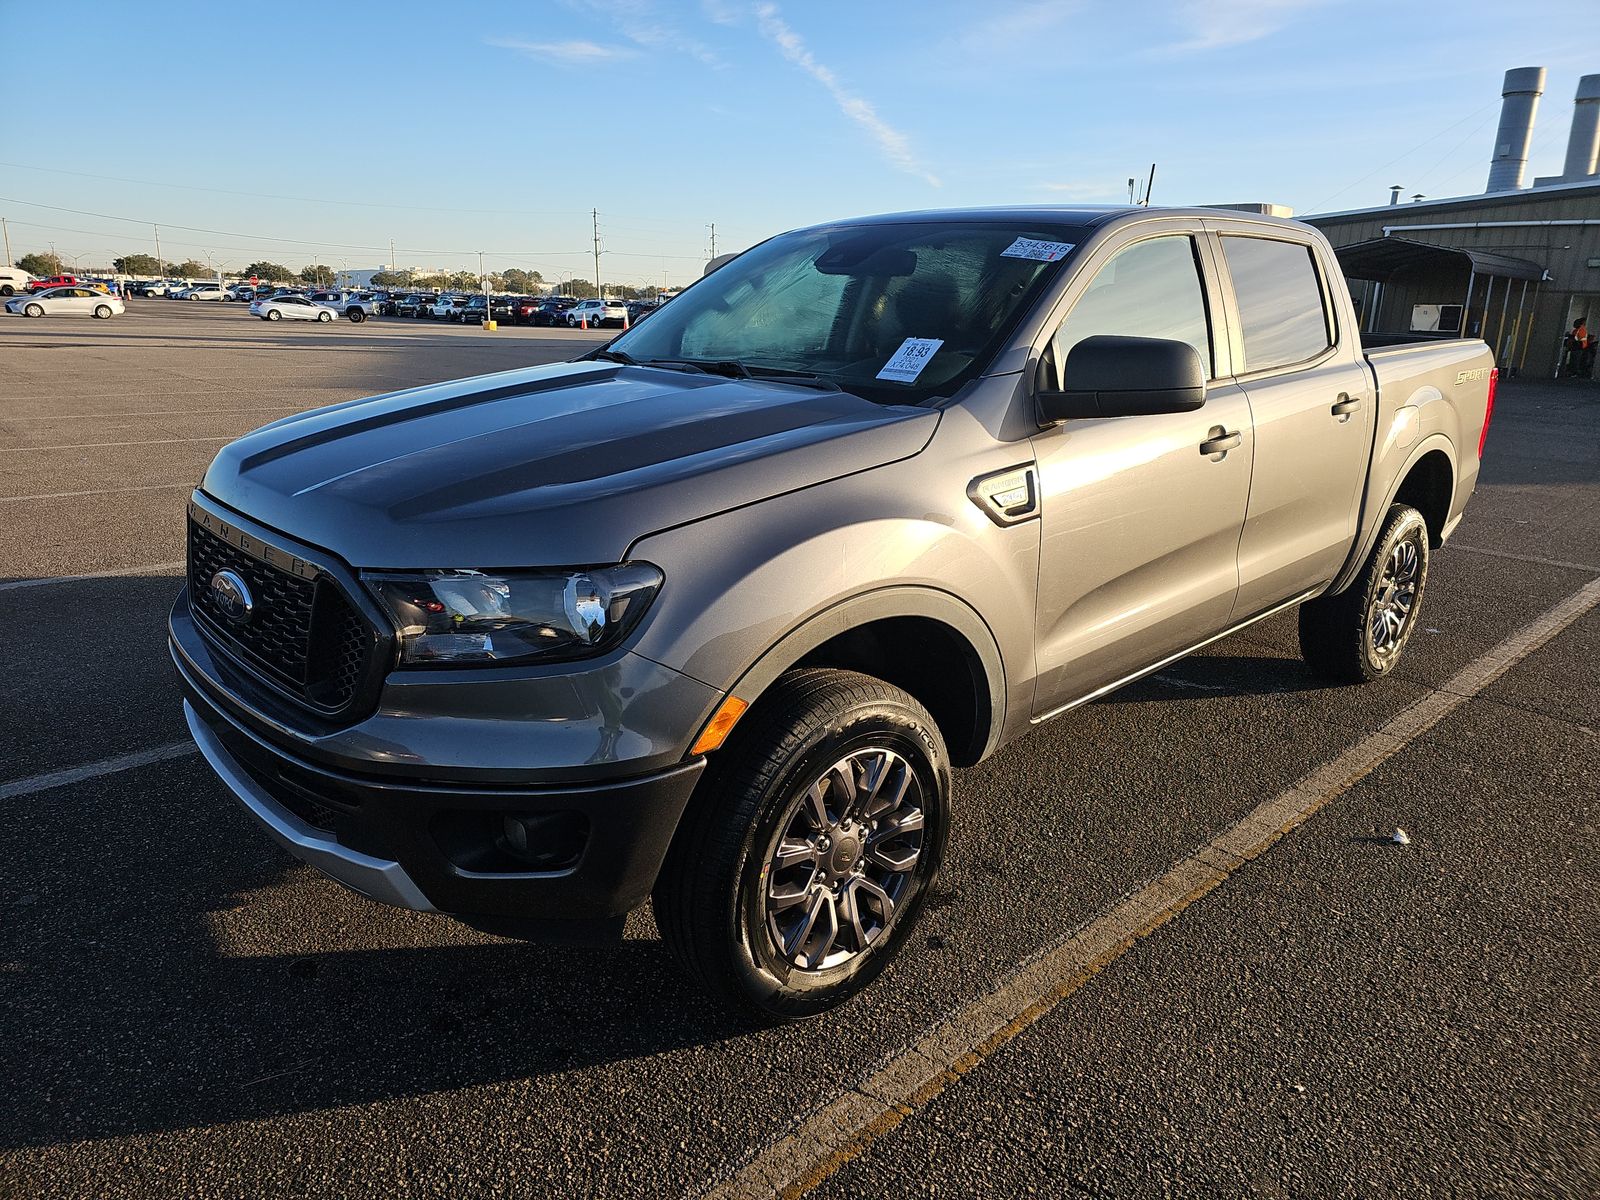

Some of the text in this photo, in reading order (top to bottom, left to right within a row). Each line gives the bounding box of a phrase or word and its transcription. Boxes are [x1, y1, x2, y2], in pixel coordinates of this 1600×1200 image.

[1014, 240, 1070, 253] 5343616
[902, 346, 931, 358] 18:93
[1454, 367, 1489, 387] SPORT
[189, 504, 305, 575] RANGER
[213, 578, 236, 612] Ford
